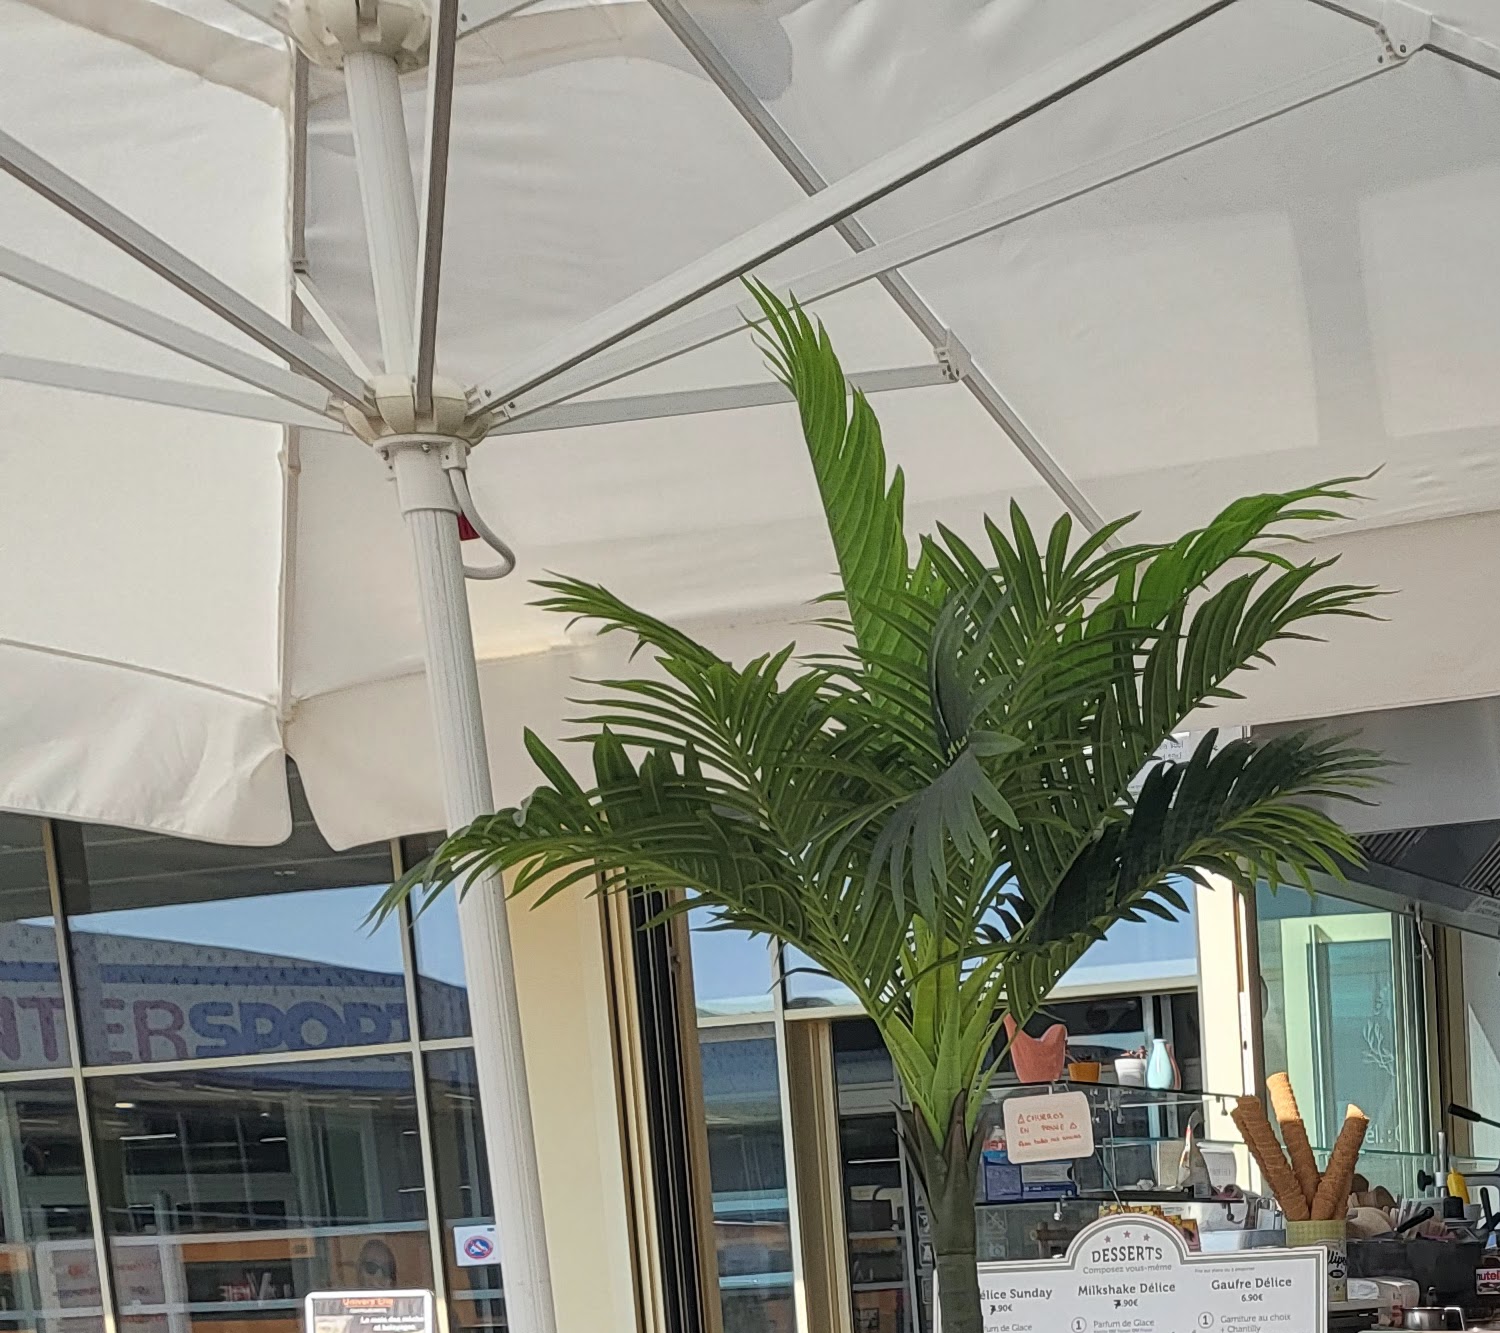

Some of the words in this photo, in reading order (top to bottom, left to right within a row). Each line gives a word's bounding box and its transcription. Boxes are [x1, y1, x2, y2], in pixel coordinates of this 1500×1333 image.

[1091, 1245, 1163, 1263] DESSERTS
[1083, 1265, 1124, 1275] Composez
[1125, 1263, 1172, 1273] vous-même
[1078, 1284, 1136, 1297] Milkshake
[1140, 1282, 1176, 1294] Délice
[1211, 1278, 1252, 1290] Gaufre
[1255, 1277, 1292, 1288] Délice
[979, 1288, 1007, 1300] élice
[1009, 1287, 1053, 1300] Sunday
[1241, 1293, 1264, 1303] 6.90€
[1093, 1319, 1121, 1329] Parfum
[1121, 1319, 1132, 1327] de
[1133, 1318, 1155, 1327] Glace
[1220, 1314, 1257, 1324] Garniture
[1258, 1314, 1268, 1323] au
[1269, 1313, 1291, 1322] choix
[1011, 1323, 1033, 1332] Glace
